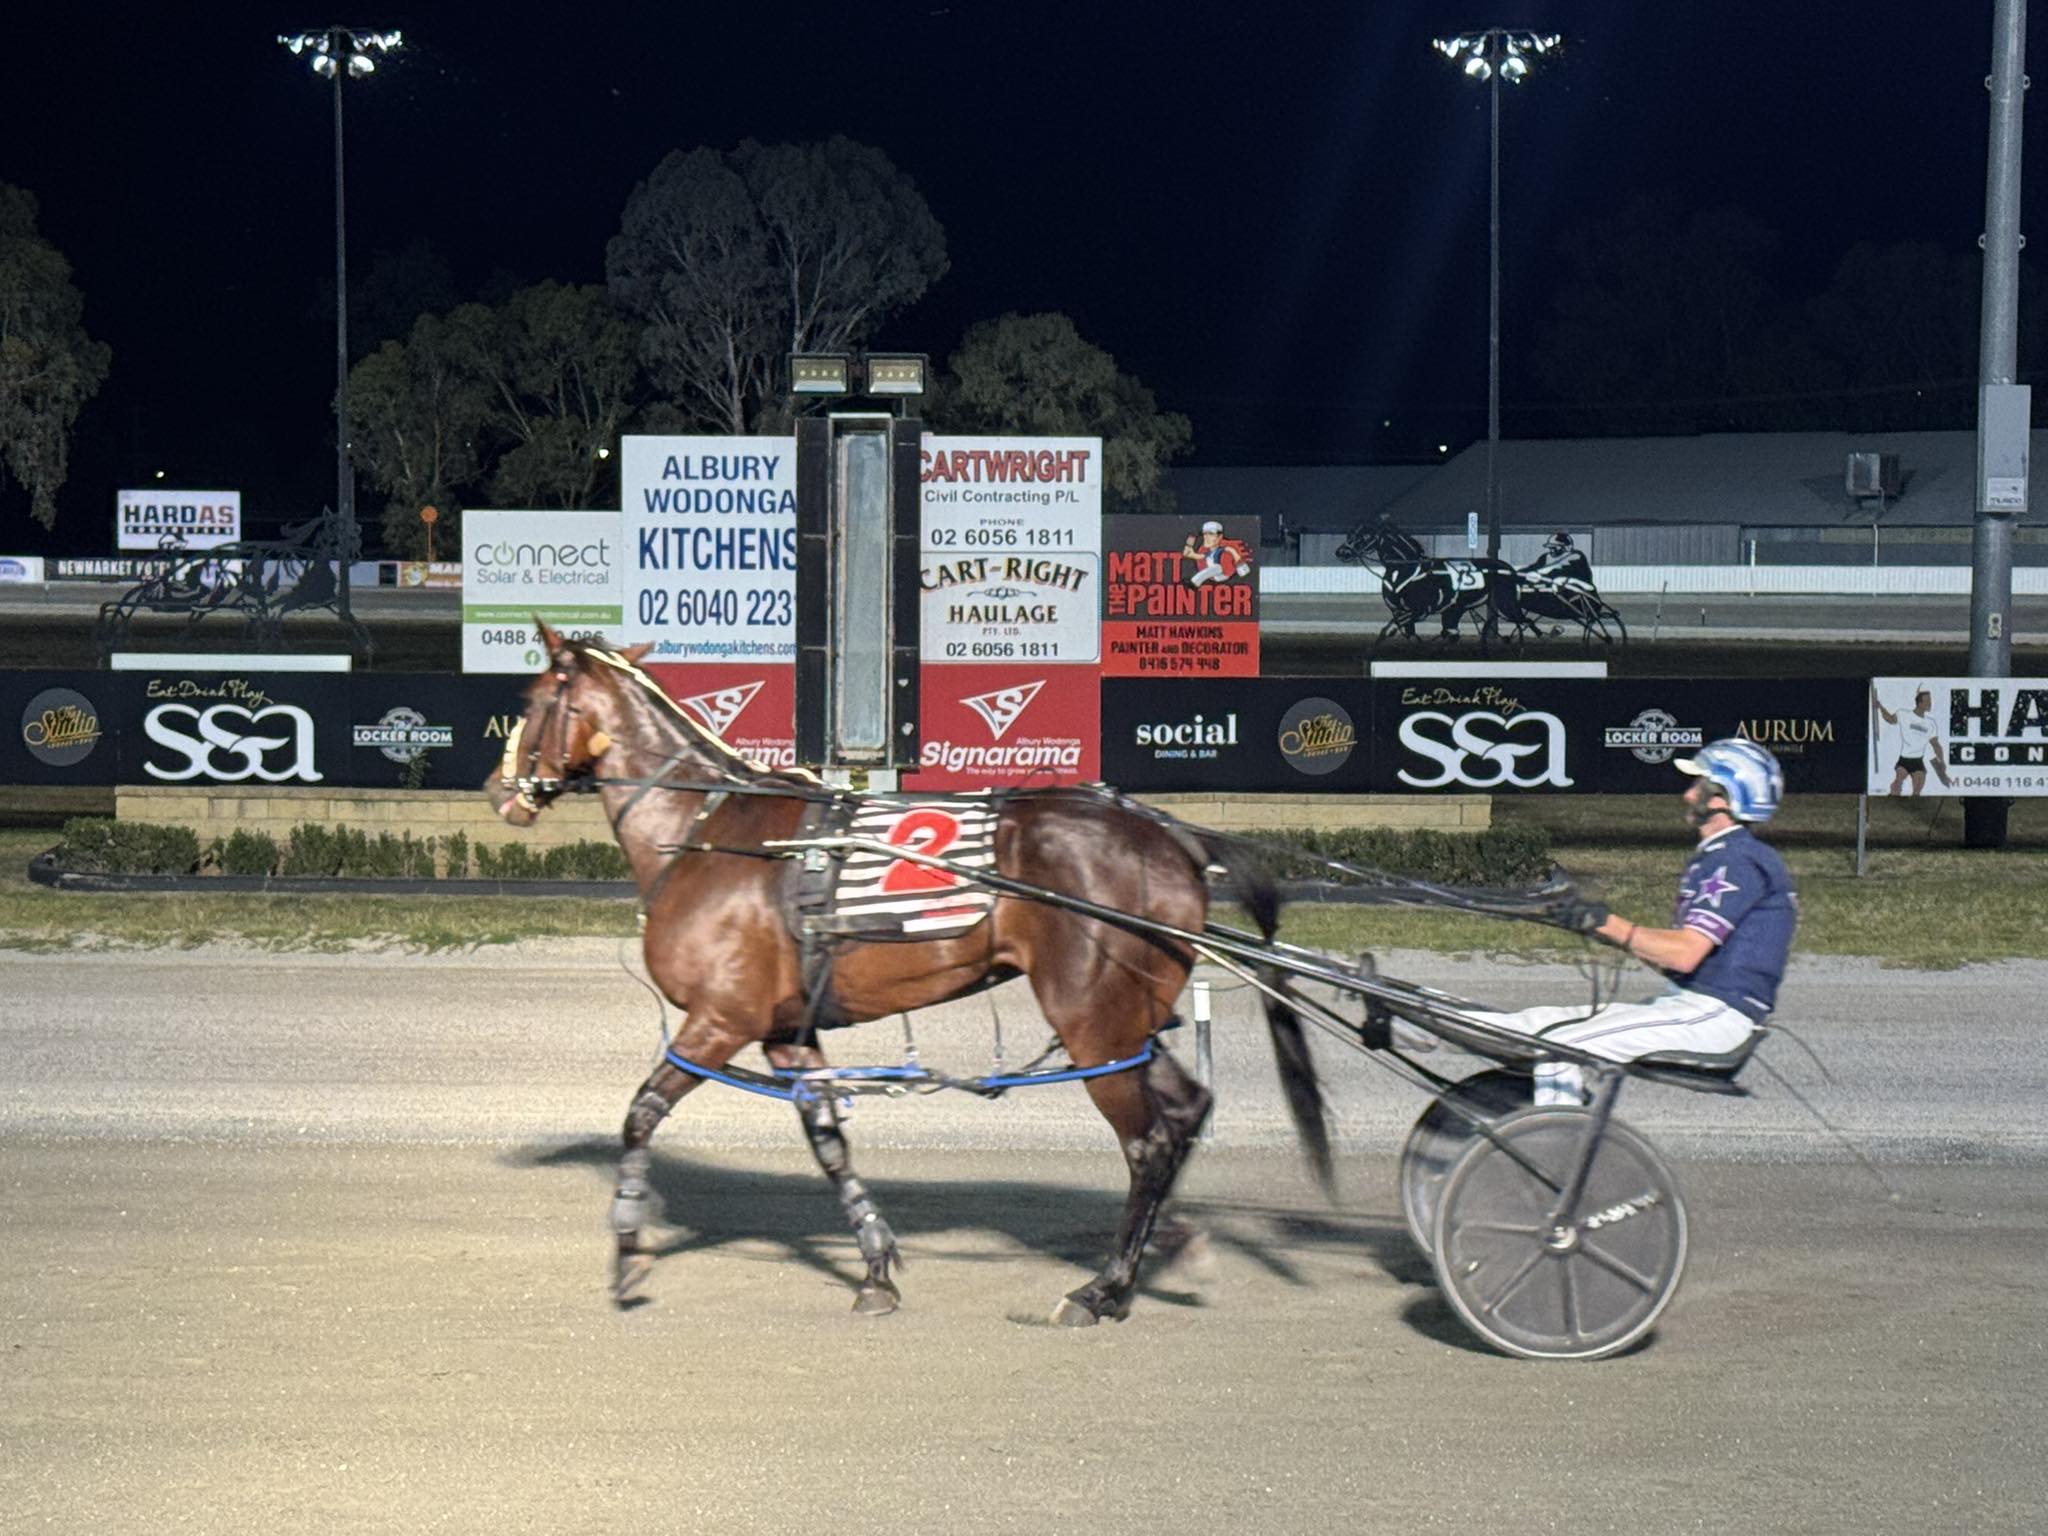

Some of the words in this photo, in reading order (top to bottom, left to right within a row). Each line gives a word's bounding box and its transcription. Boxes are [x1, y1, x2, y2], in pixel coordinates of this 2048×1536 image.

[662, 455, 780, 481] ALBURY
[920, 450, 1090, 483] CARTWRIGHT
[644, 488, 797, 514] WODONGA
[924, 490, 957, 503] Civil
[962, 490, 1050, 505] Contracting
[1055, 490, 1079, 503] P/L
[931, 529, 957, 545] 02
[965, 529, 1017, 545] 6056
[1025, 529, 1074, 545] 1811
[475, 538, 610, 567] connect
[639, 527, 797, 571] KITCHENS
[58, 560, 132, 575] NEWMARKET
[477, 569, 516, 584] Solar
[522, 569, 533, 584] &
[539, 568, 609, 584] Electrical
[639, 589, 669, 625] 02
[677, 589, 738, 626] 6040
[746, 589, 797, 626] 223
[946, 605, 1059, 625] HAULAGE
[482, 630, 526, 645] 0488
[1136, 626, 1166, 639] MATT
[946, 643, 967, 657] 02
[972, 643, 1014, 657] 6056
[1020, 643, 1059, 657] 1811
[1111, 641, 1158, 655] PAINTER
[1181, 642, 1248, 655] DECORATOR
[146, 680, 177, 697] Eat
[179, 680, 227, 698] Drink
[228, 679, 274, 708] Play
[1401, 687, 1432, 705] Eat
[1433, 687, 1480, 705] Drink
[1482, 686, 1527, 715] Play
[354, 730, 406, 742] LOCKER
[411, 730, 453, 742] ROOM
[1136, 714, 1238, 745] social
[1605, 732, 1657, 743] LOCKER
[1661, 732, 1702, 743] ROOM
[1734, 719, 1834, 742] AURUM
[920, 740, 1081, 773] Signarama
[1154, 749, 1188, 759] DINING
[1190, 749, 1197, 759] &
[1199, 749, 1217, 759] BAR
[966, 767, 980, 775] The
[882, 808, 963, 894] 2
